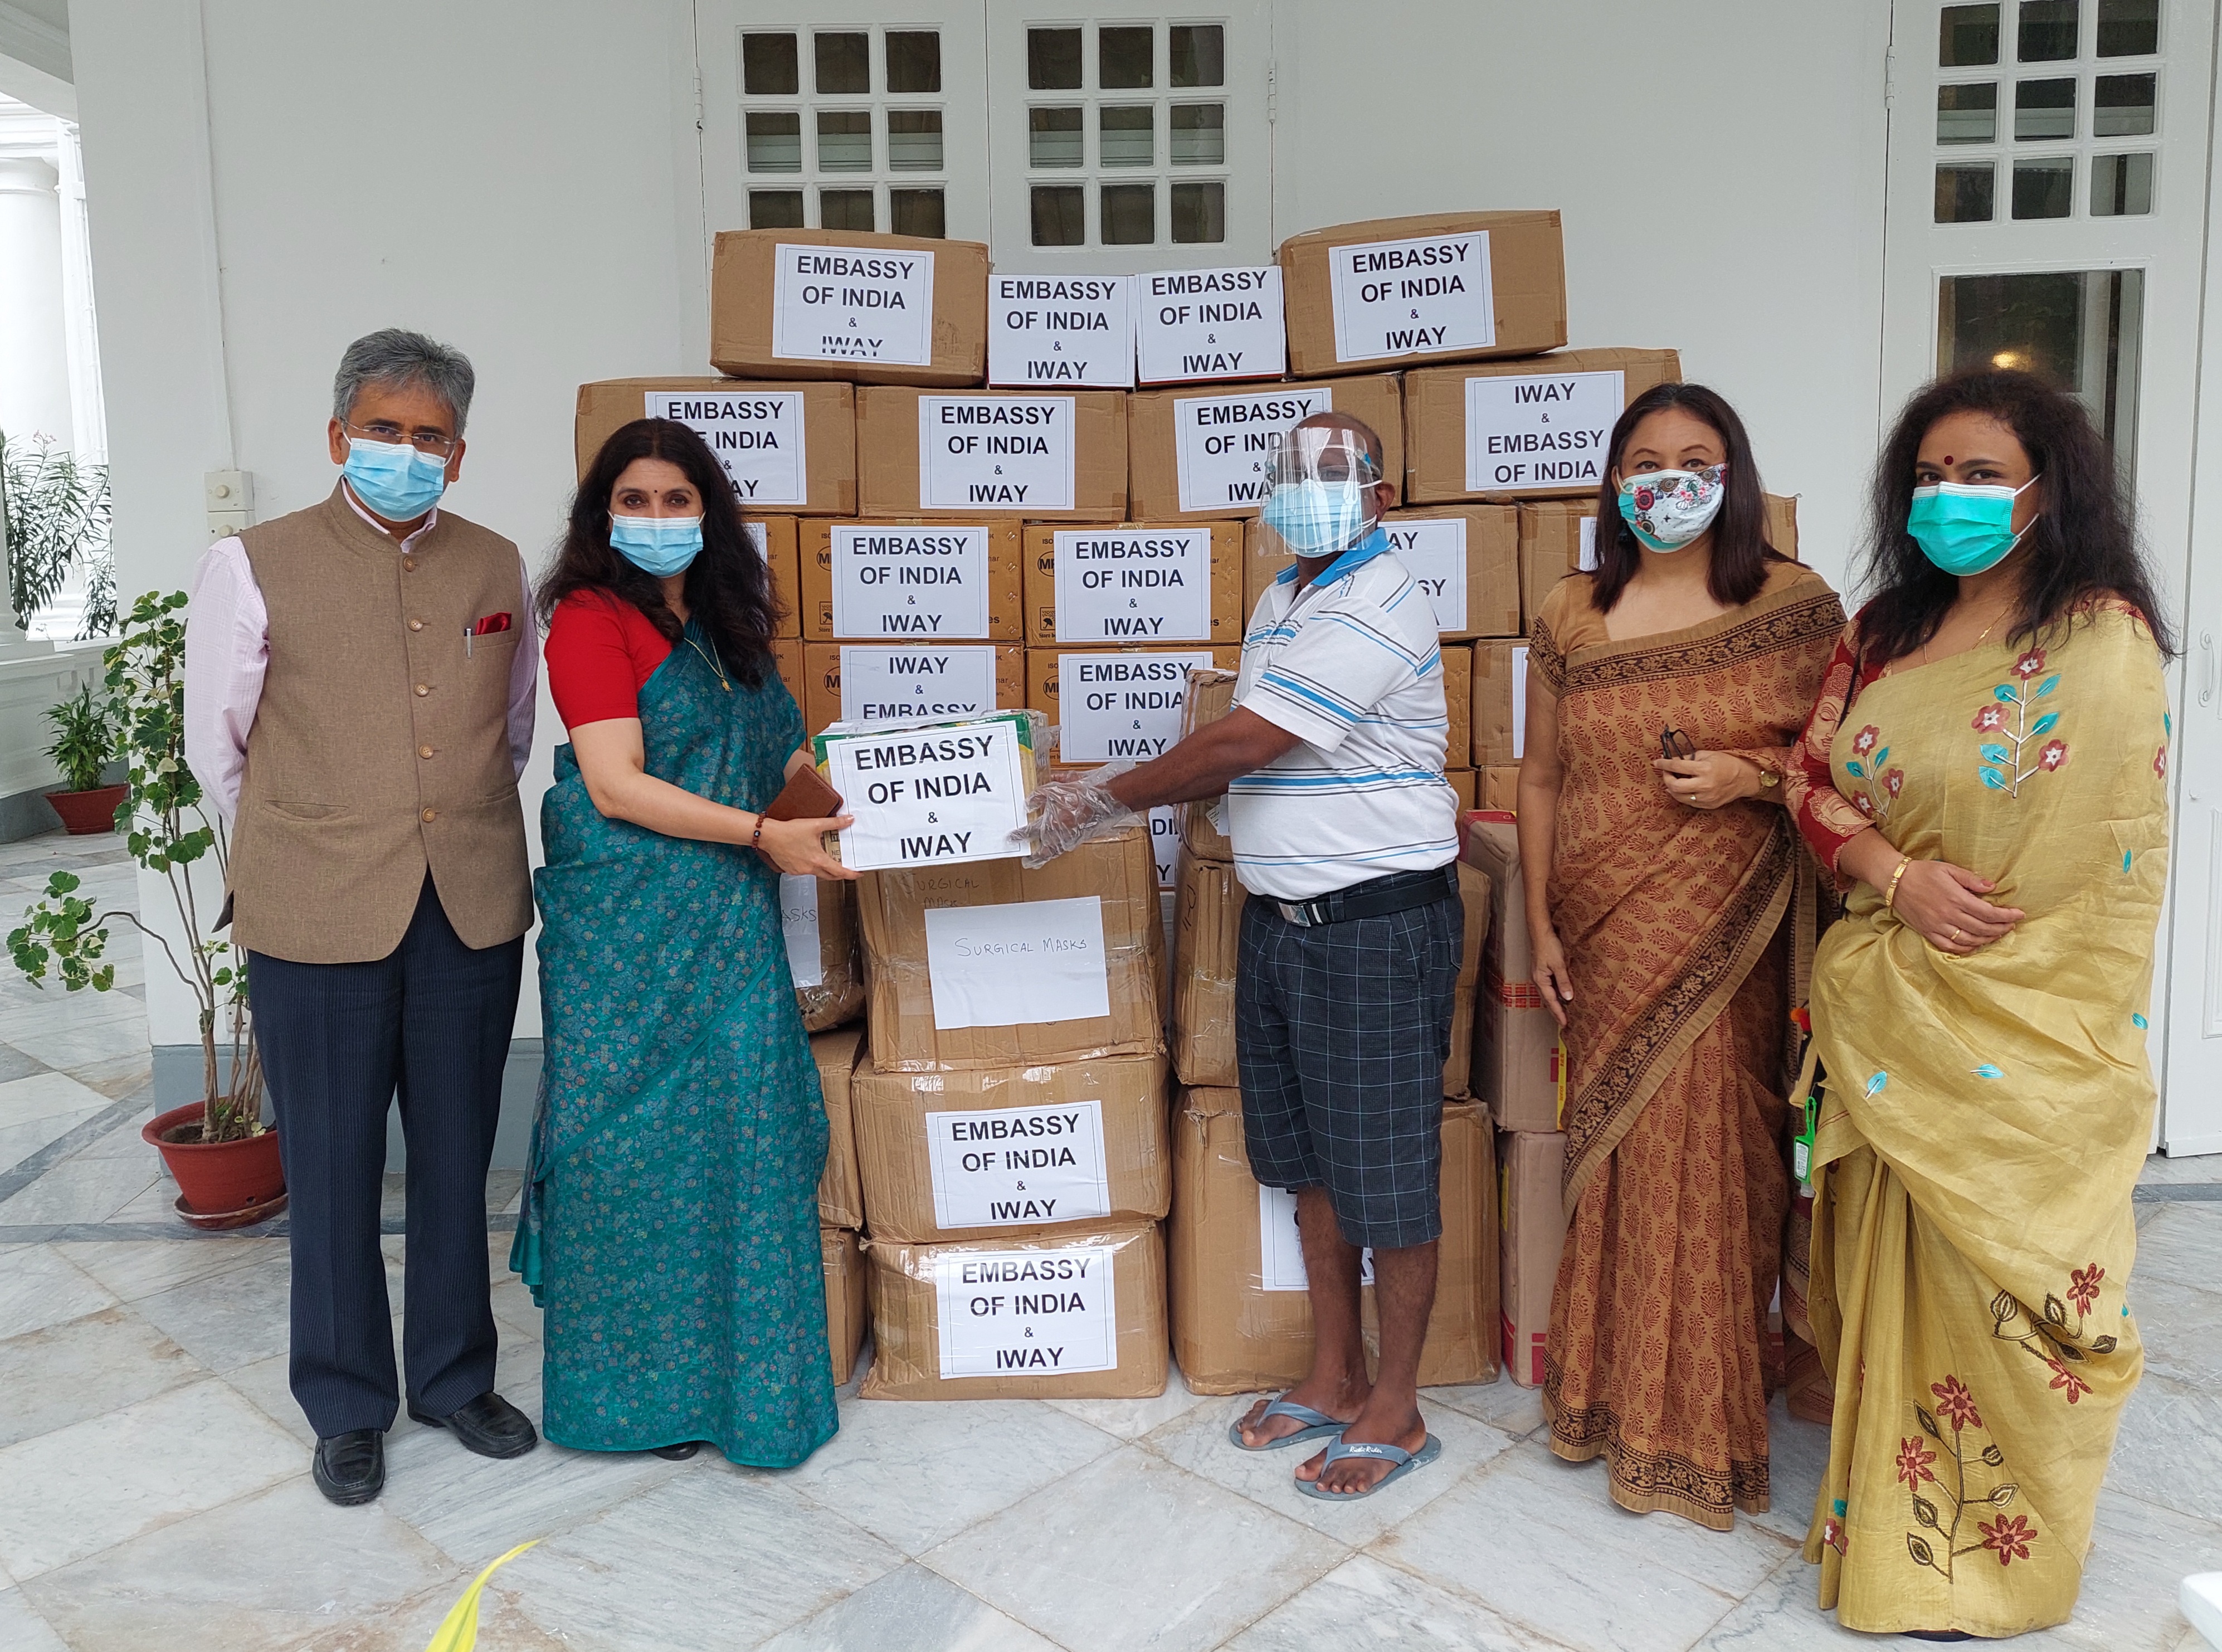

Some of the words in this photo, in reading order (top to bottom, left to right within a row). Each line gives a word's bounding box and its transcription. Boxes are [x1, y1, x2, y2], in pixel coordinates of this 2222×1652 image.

[797, 255, 914, 280] EMBASSY
[1352, 243, 1470, 274] EMBASSY
[1001, 280, 1116, 300] EMBASSY
[1152, 270, 1267, 296] EMBASSY
[1361, 281, 1392, 303] OF
[1401, 275, 1465, 299] INDIA
[802, 286, 834, 305] OF
[842, 288, 906, 310] INDIA
[849, 317, 857, 328] &
[1006, 311, 1038, 330] OF
[1046, 311, 1109, 330] INDIA
[1159, 306, 1191, 325] OF
[1199, 301, 1263, 323] INDIA
[1410, 309, 1419, 319] &
[822, 335, 883, 357] IWAY
[1053, 341, 1062, 352] &
[1207, 333, 1216, 344] &
[1386, 326, 1447, 350] IWAY
[1028, 360, 1088, 379] IWAY
[1183, 352, 1243, 374] IWAY
[1515, 382, 1576, 404] IWAY
[668, 401, 784, 420] EMBASSY
[941, 406, 1055, 425] EMBASSY
[1197, 399, 1312, 426] EMBASSY
[1541, 413, 1550, 423] &
[715, 431, 779, 449] INDIA
[948, 436, 979, 454] OF
[987, 436, 1049, 455] INDIA
[1205, 435, 1236, 455] OF
[1488, 430, 1604, 454] EMBASSY
[994, 465, 1003, 475] &
[1253, 462, 1261, 472] &
[1494, 464, 1526, 483] OF
[1534, 460, 1598, 481] INDIA
[731, 479, 759, 498] AY
[969, 485, 1029, 503] IWAY
[853, 537, 968, 555] EMBASSY
[1076, 539, 1191, 559] EMBASSY
[1388, 532, 1419, 550] AY
[860, 567, 891, 584] OF
[899, 567, 962, 584] INDIA
[1082, 571, 1113, 589] OF
[1122, 569, 1184, 588] INDIA
[907, 595, 916, 605] &
[1129, 598, 1138, 608] &
[883, 615, 942, 632] IWAY
[1104, 617, 1164, 636] IWAY
[889, 657, 949, 674] IWAY
[1080, 662, 1193, 682] EMBASSY
[915, 684, 924, 695] &
[1086, 693, 1117, 711] OF
[1125, 691, 1183, 710] INDIA
[1132, 719, 1141, 730] &
[855, 735, 993, 771] EMBASSY
[1108, 738, 1167, 757] IWAY
[868, 781, 904, 804] OF
[914, 772, 992, 800] INDIA
[928, 812, 938, 823] &
[900, 831, 972, 860] IWAY
[954, 938, 1034, 957] SURGICAL
[1042, 937, 1087, 953] MASKS
[952, 1113, 1079, 1141] EMBASSY
[962, 1152, 996, 1172] OF
[1006, 1147, 1076, 1169] INDIA
[1017, 1181, 1026, 1191] &
[991, 1199, 1056, 1220] IWAY
[962, 1258, 1091, 1284] EMBASSY
[970, 1296, 1005, 1315] OF
[1015, 1292, 1085, 1315] INDIA
[1024, 1327, 1033, 1338] &
[997, 1347, 1064, 1369] IWAY
